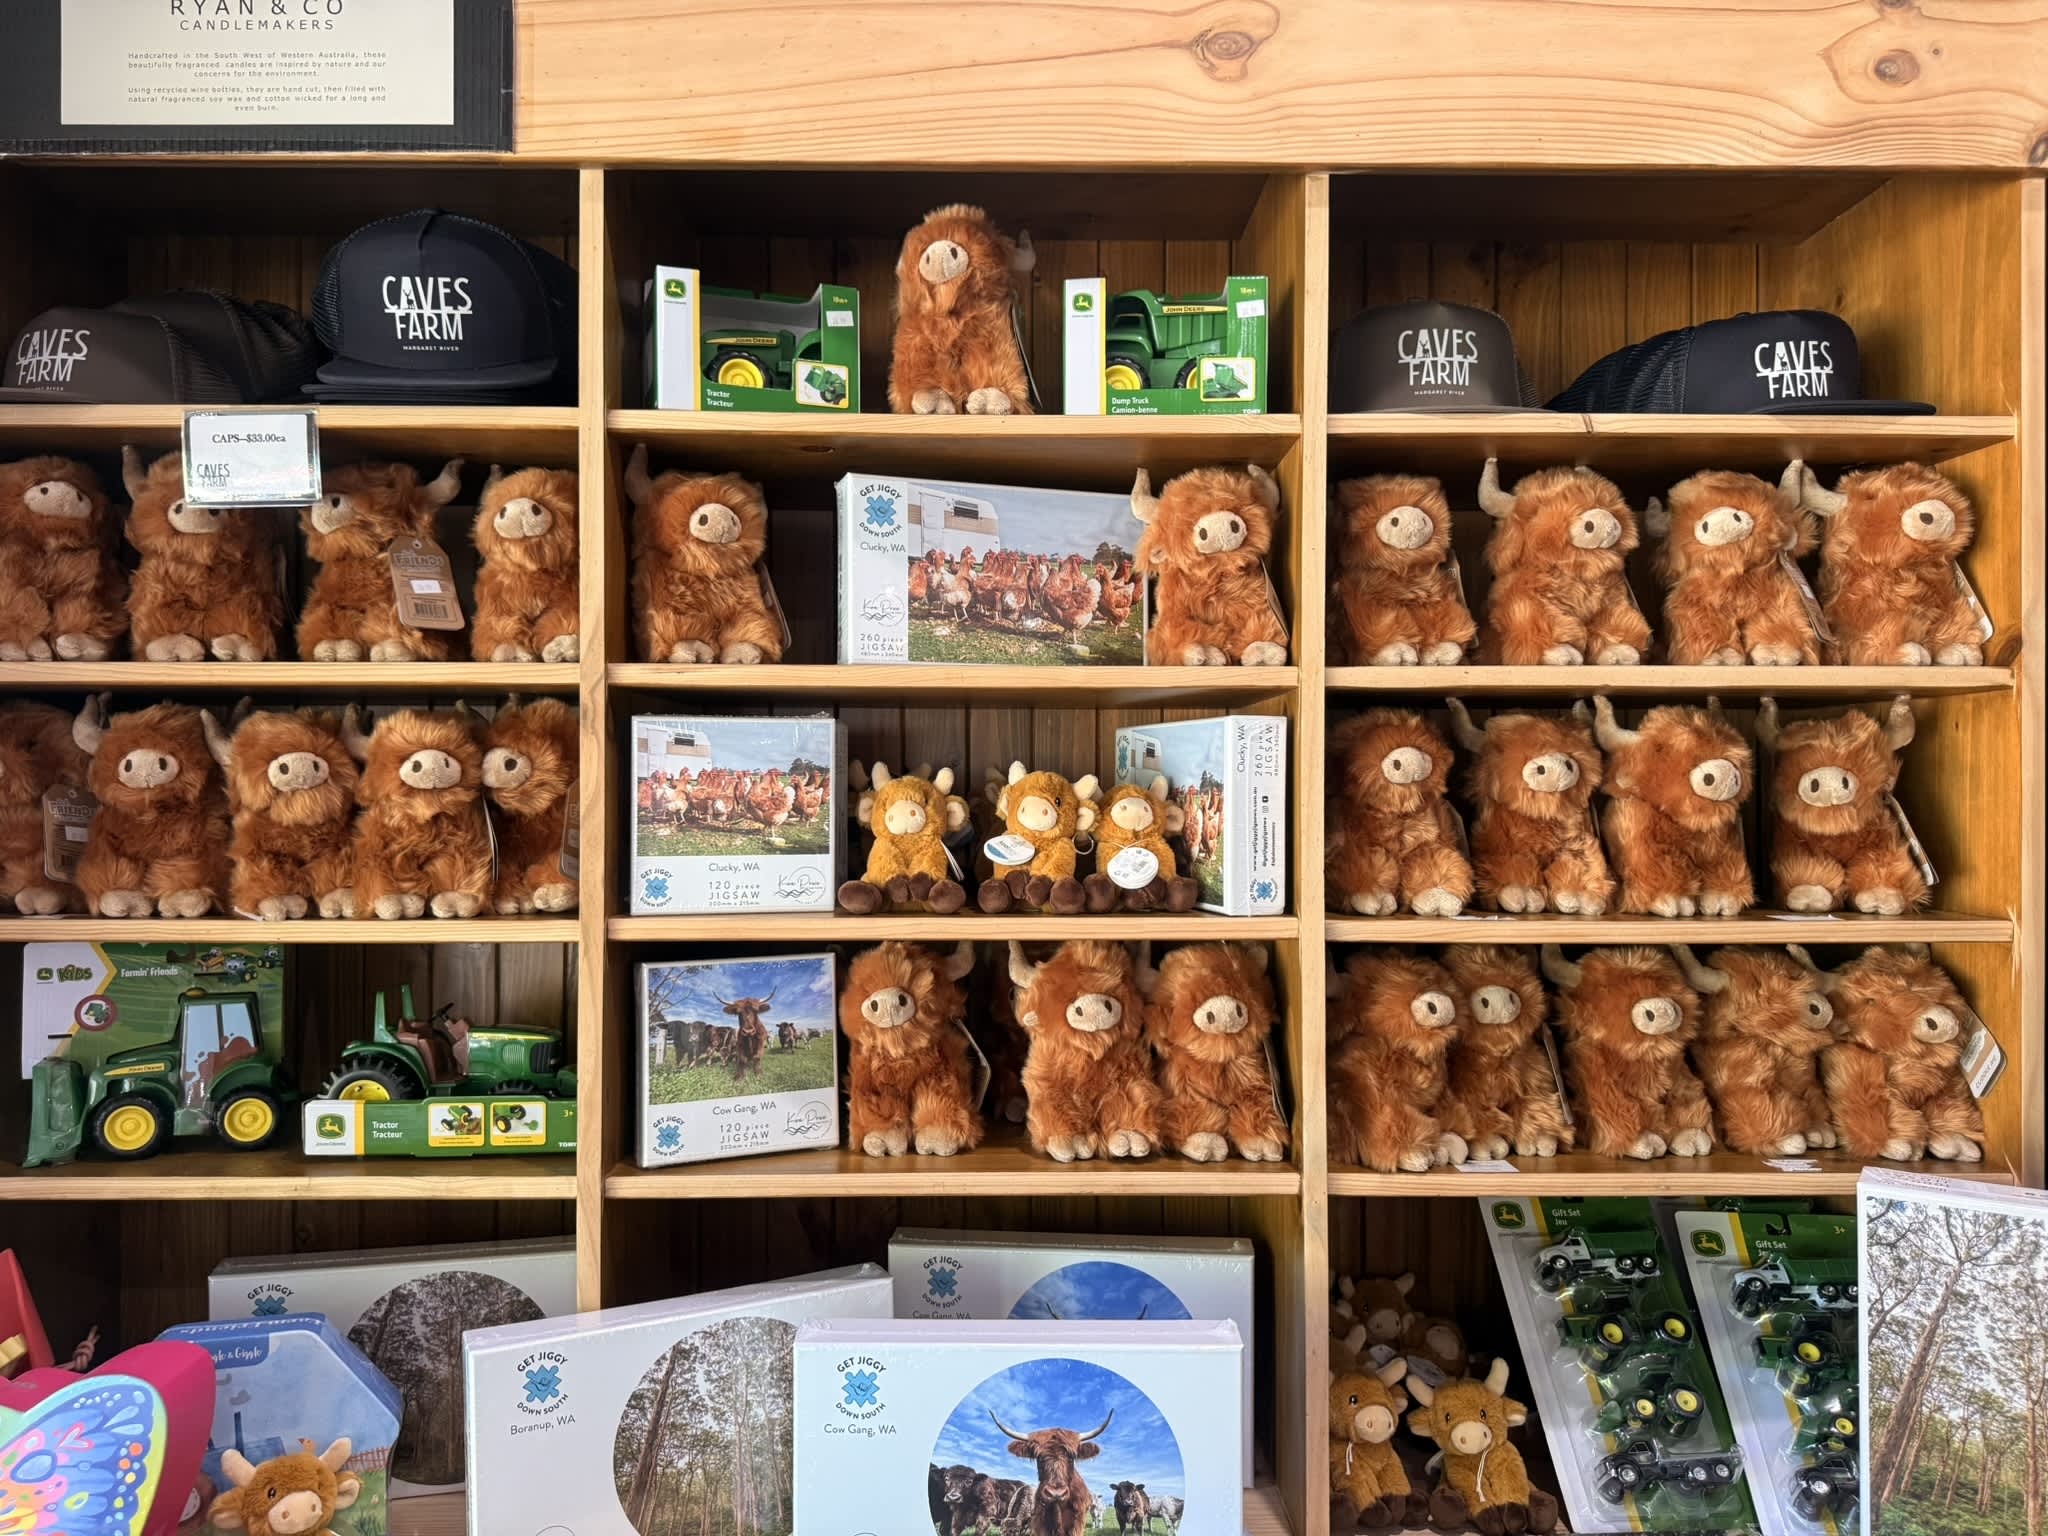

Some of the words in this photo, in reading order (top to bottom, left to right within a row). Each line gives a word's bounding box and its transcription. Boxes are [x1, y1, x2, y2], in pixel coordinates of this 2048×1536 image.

[171, 0, 253, 15] RYAN
[271, 0, 287, 15] &
[303, 0, 343, 15] CO
[180, 20, 334, 30] CANDLEMAKERS
[318, 51, 359, 59] Australia,
[128, 61, 172, 69] beautifully
[175, 61, 220, 69] fragranced
[225, 61, 257, 69] candles
[260, 61, 272, 69] are
[276, 61, 309, 69] inspired
[312, 61, 321, 69] by
[325, 61, 352, 69] nature
[354, 61, 369, 69] and
[372, 61, 386, 69] our
[382, 276, 472, 312] CAVES
[395, 312, 463, 340] FARM
[18, 329, 91, 362] CAVES
[1398, 329, 1478, 360] CAVES
[1754, 340, 1833, 373] CAVES
[18, 357, 74, 385] FARM
[1409, 360, 1469, 386] FARM
[1768, 372, 1828, 399] FARM
[706, 389, 730, 398] Tractor
[706, 399, 734, 408] Tracteur
[1112, 406, 1158, 414] Camion-benne
[197, 464, 230, 478] CAVES
[860, 484, 874, 496] GET
[877, 484, 902, 499] JIGGY
[859, 522, 879, 536] DOWN
[881, 524, 902, 537] SOUTH
[860, 541, 889, 554] Clucky,
[890, 543, 906, 552] WA
[860, 642, 903, 651] JIGSAW
[1238, 724, 1246, 741] WA
[1237, 743, 1247, 772] Clucky,
[1265, 726, 1273, 776] JIGSAW
[1255, 754, 1263, 776] 260
[708, 862, 741, 874] Clucky,
[744, 862, 760, 870] WA
[710, 881, 730, 890] 120
[709, 891, 760, 900] JIGSAW
[150, 968, 178, 977] Friends
[564, 1110, 574, 1118] 3+
[712, 1106, 731, 1115] Cow
[734, 1104, 758, 1114] Gang,
[760, 1101, 776, 1110] WA
[372, 1121, 399, 1129] Tractor
[720, 1122, 741, 1133] 120
[720, 1131, 769, 1144] JIGSAW
[1834, 1226, 1846, 1234] 3+
[1755, 1241, 1772, 1249] Gift
[1774, 1241, 1787, 1249] Set
[923, 1256, 937, 1269] GET
[939, 1256, 963, 1270] JIGGY
[248, 1285, 264, 1299] GET
[267, 1284, 294, 1296] JIGGY
[235, 1346, 262, 1360] Giggle
[517, 1354, 535, 1372] GET
[538, 1352, 568, 1365] JIGGY
[837, 1357, 854, 1372] GET
[857, 1356, 886, 1373] JIGGY
[517, 1402, 542, 1416] DOWN
[544, 1394, 568, 1414] SOUTH
[836, 1402, 859, 1419] DOWN
[861, 1402, 886, 1420] SOUTH
[511, 1422, 554, 1435] Boranup,
[557, 1415, 576, 1426] WA
[824, 1424, 845, 1433] Cow
[848, 1424, 876, 1438] Gang,
[879, 1424, 897, 1434] WA
